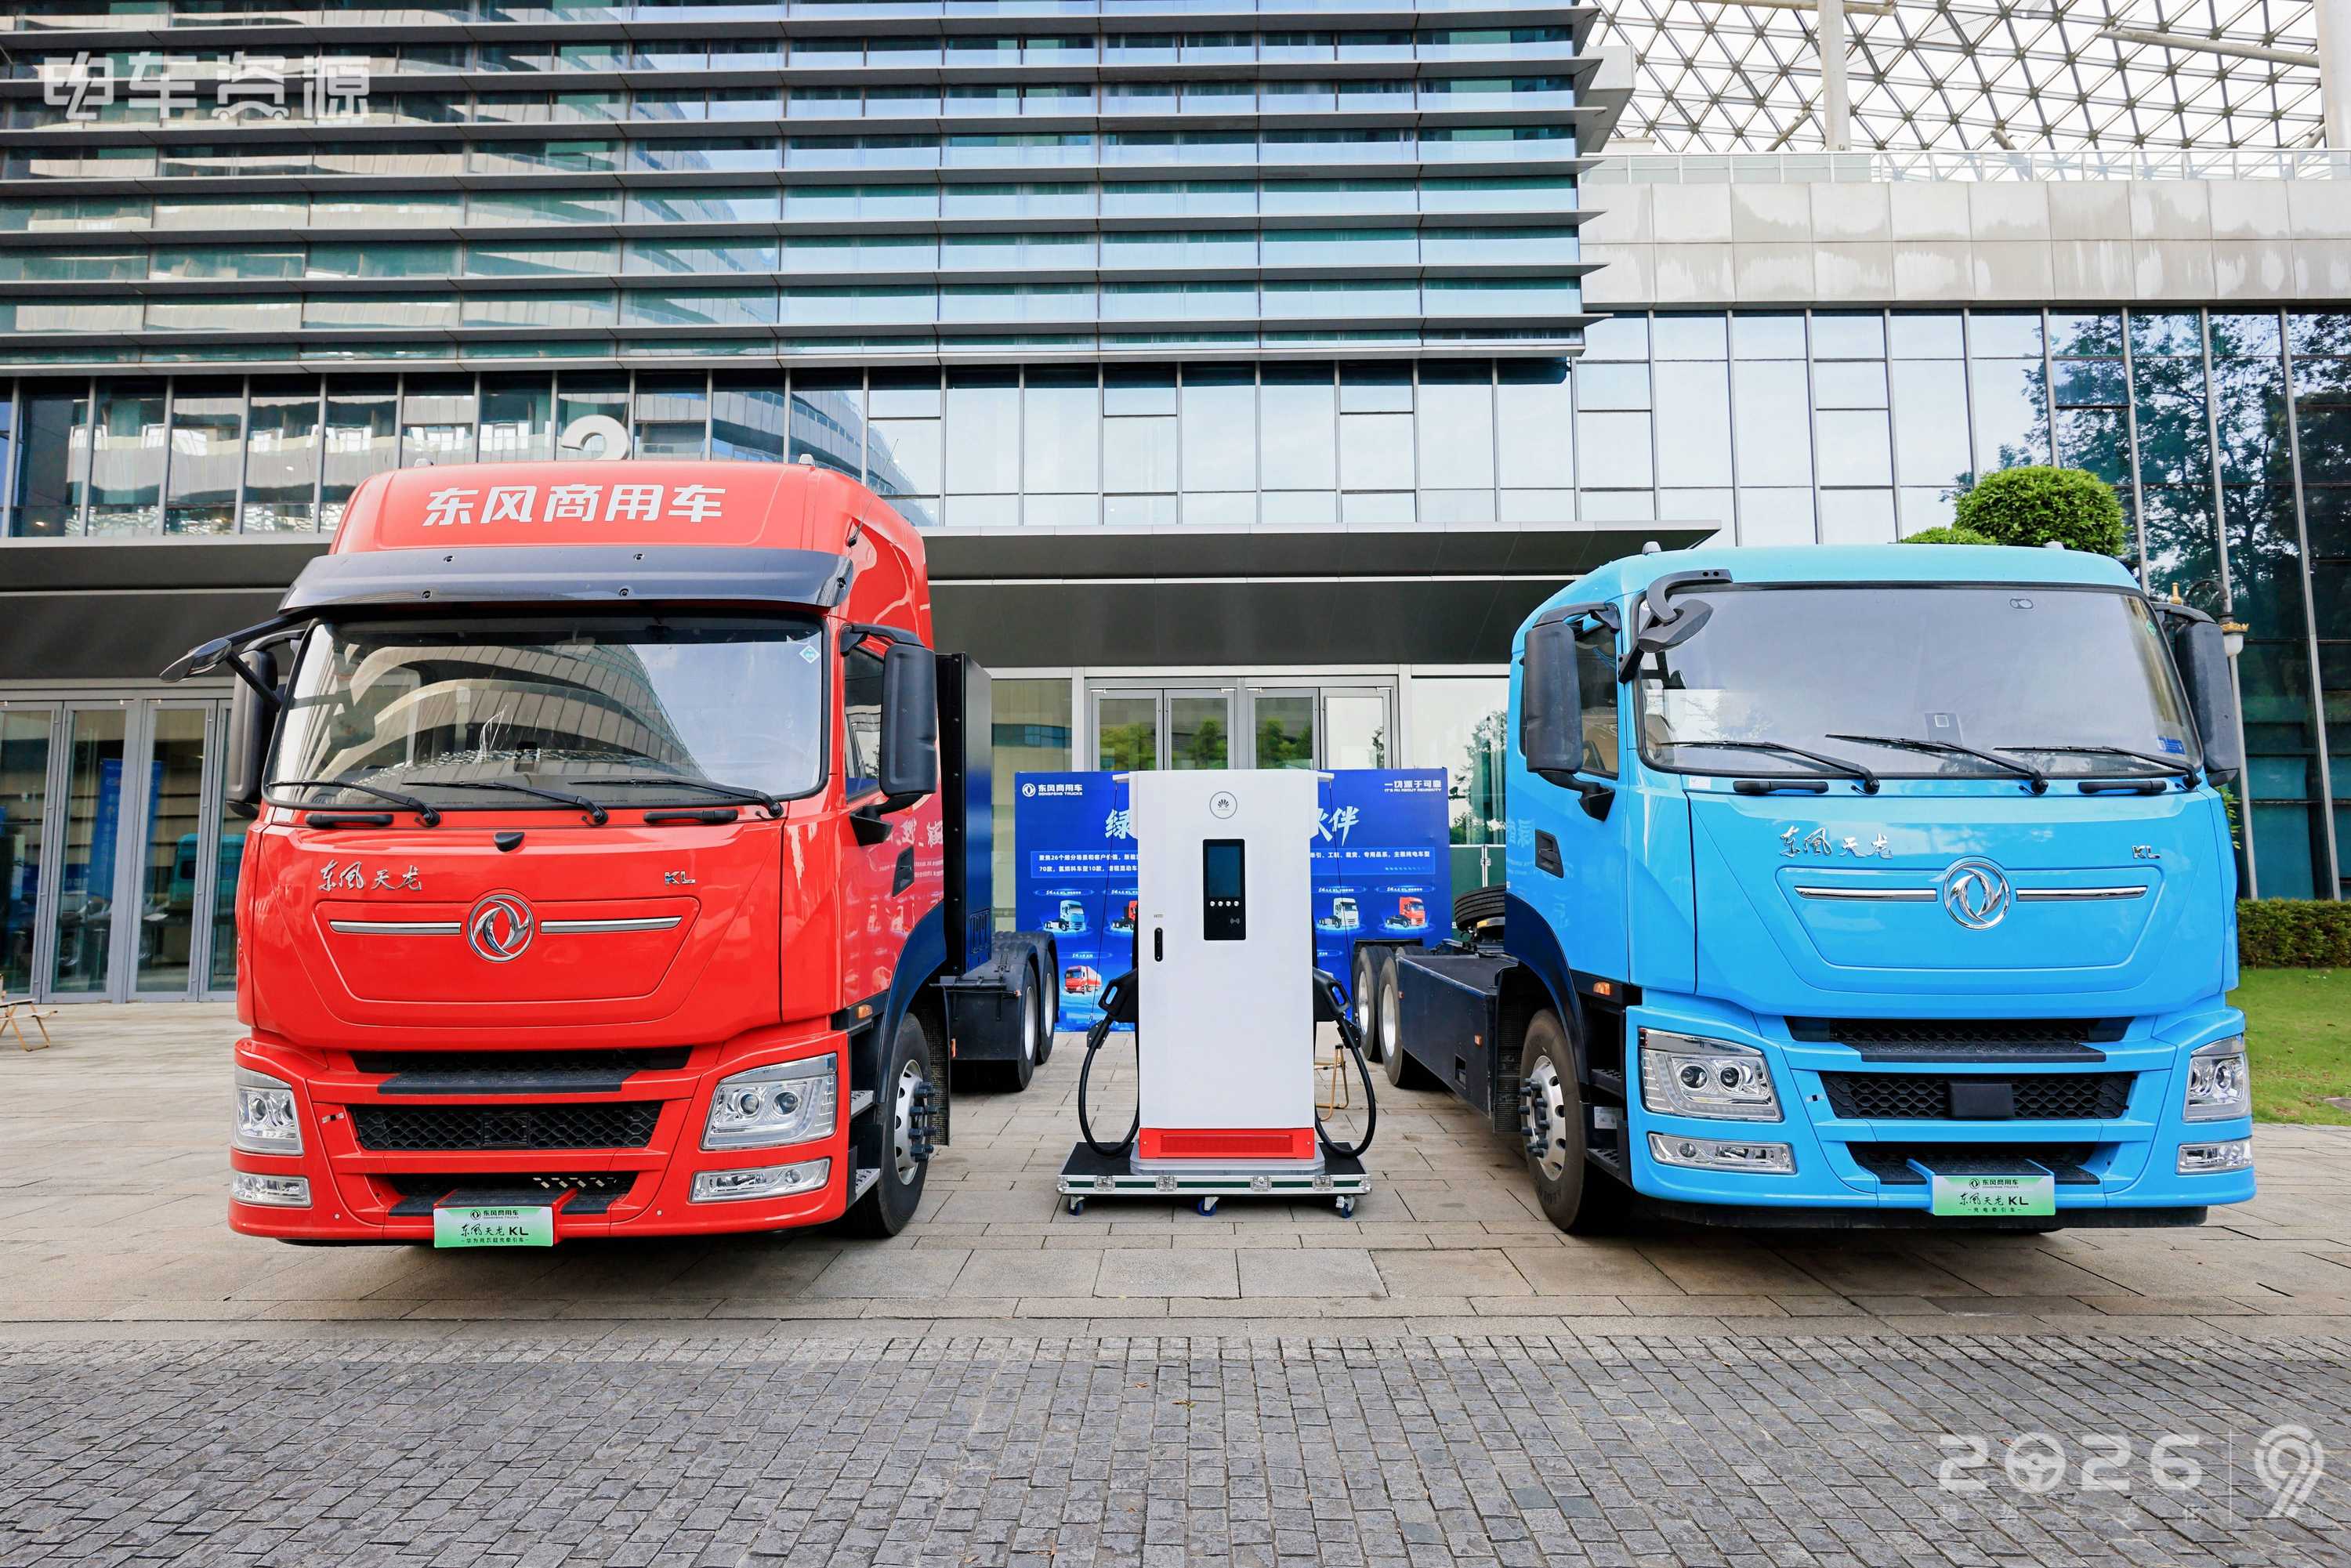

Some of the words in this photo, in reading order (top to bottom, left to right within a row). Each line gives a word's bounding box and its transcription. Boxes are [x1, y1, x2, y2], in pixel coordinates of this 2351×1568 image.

[422, 483, 726, 527] 东风商用车
[2132, 845, 2161, 860] KL
[664, 871, 697, 887] KL
[2009, 1196, 2029, 1205] KL
[509, 1226, 529, 1236] KL
